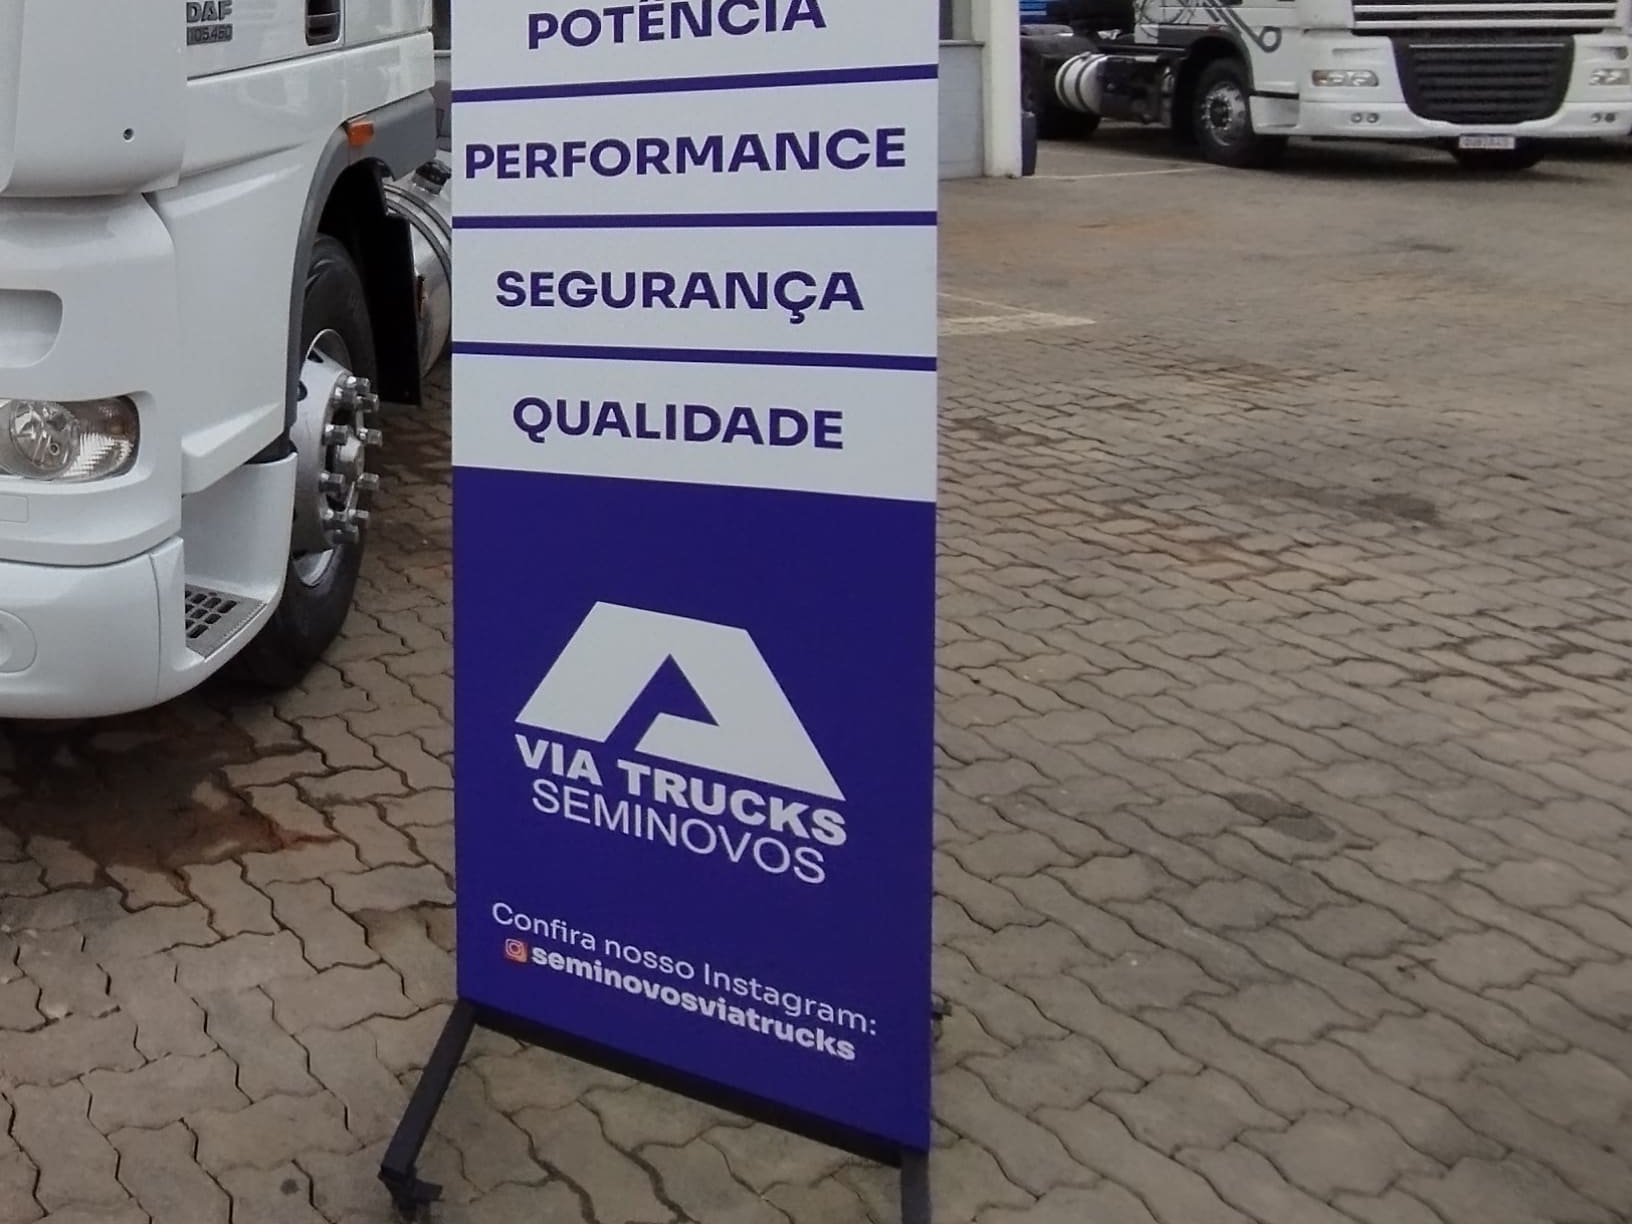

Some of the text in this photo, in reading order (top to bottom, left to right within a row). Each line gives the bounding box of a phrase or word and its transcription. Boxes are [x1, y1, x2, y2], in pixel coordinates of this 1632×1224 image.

[186, 0, 233, 23] DAF
[465, 127, 907, 180] PERFORMANCE
[496, 270, 864, 324] SEGURANÇA
[513, 396, 844, 449] QUALIDADE
[515, 733, 848, 846] VIA TRUCKS
[531, 779, 826, 884] SEMINOVOS
[492, 902, 878, 1036] Confira nosso Instagram:
[531, 945, 856, 1062] seminovosviatrucks
